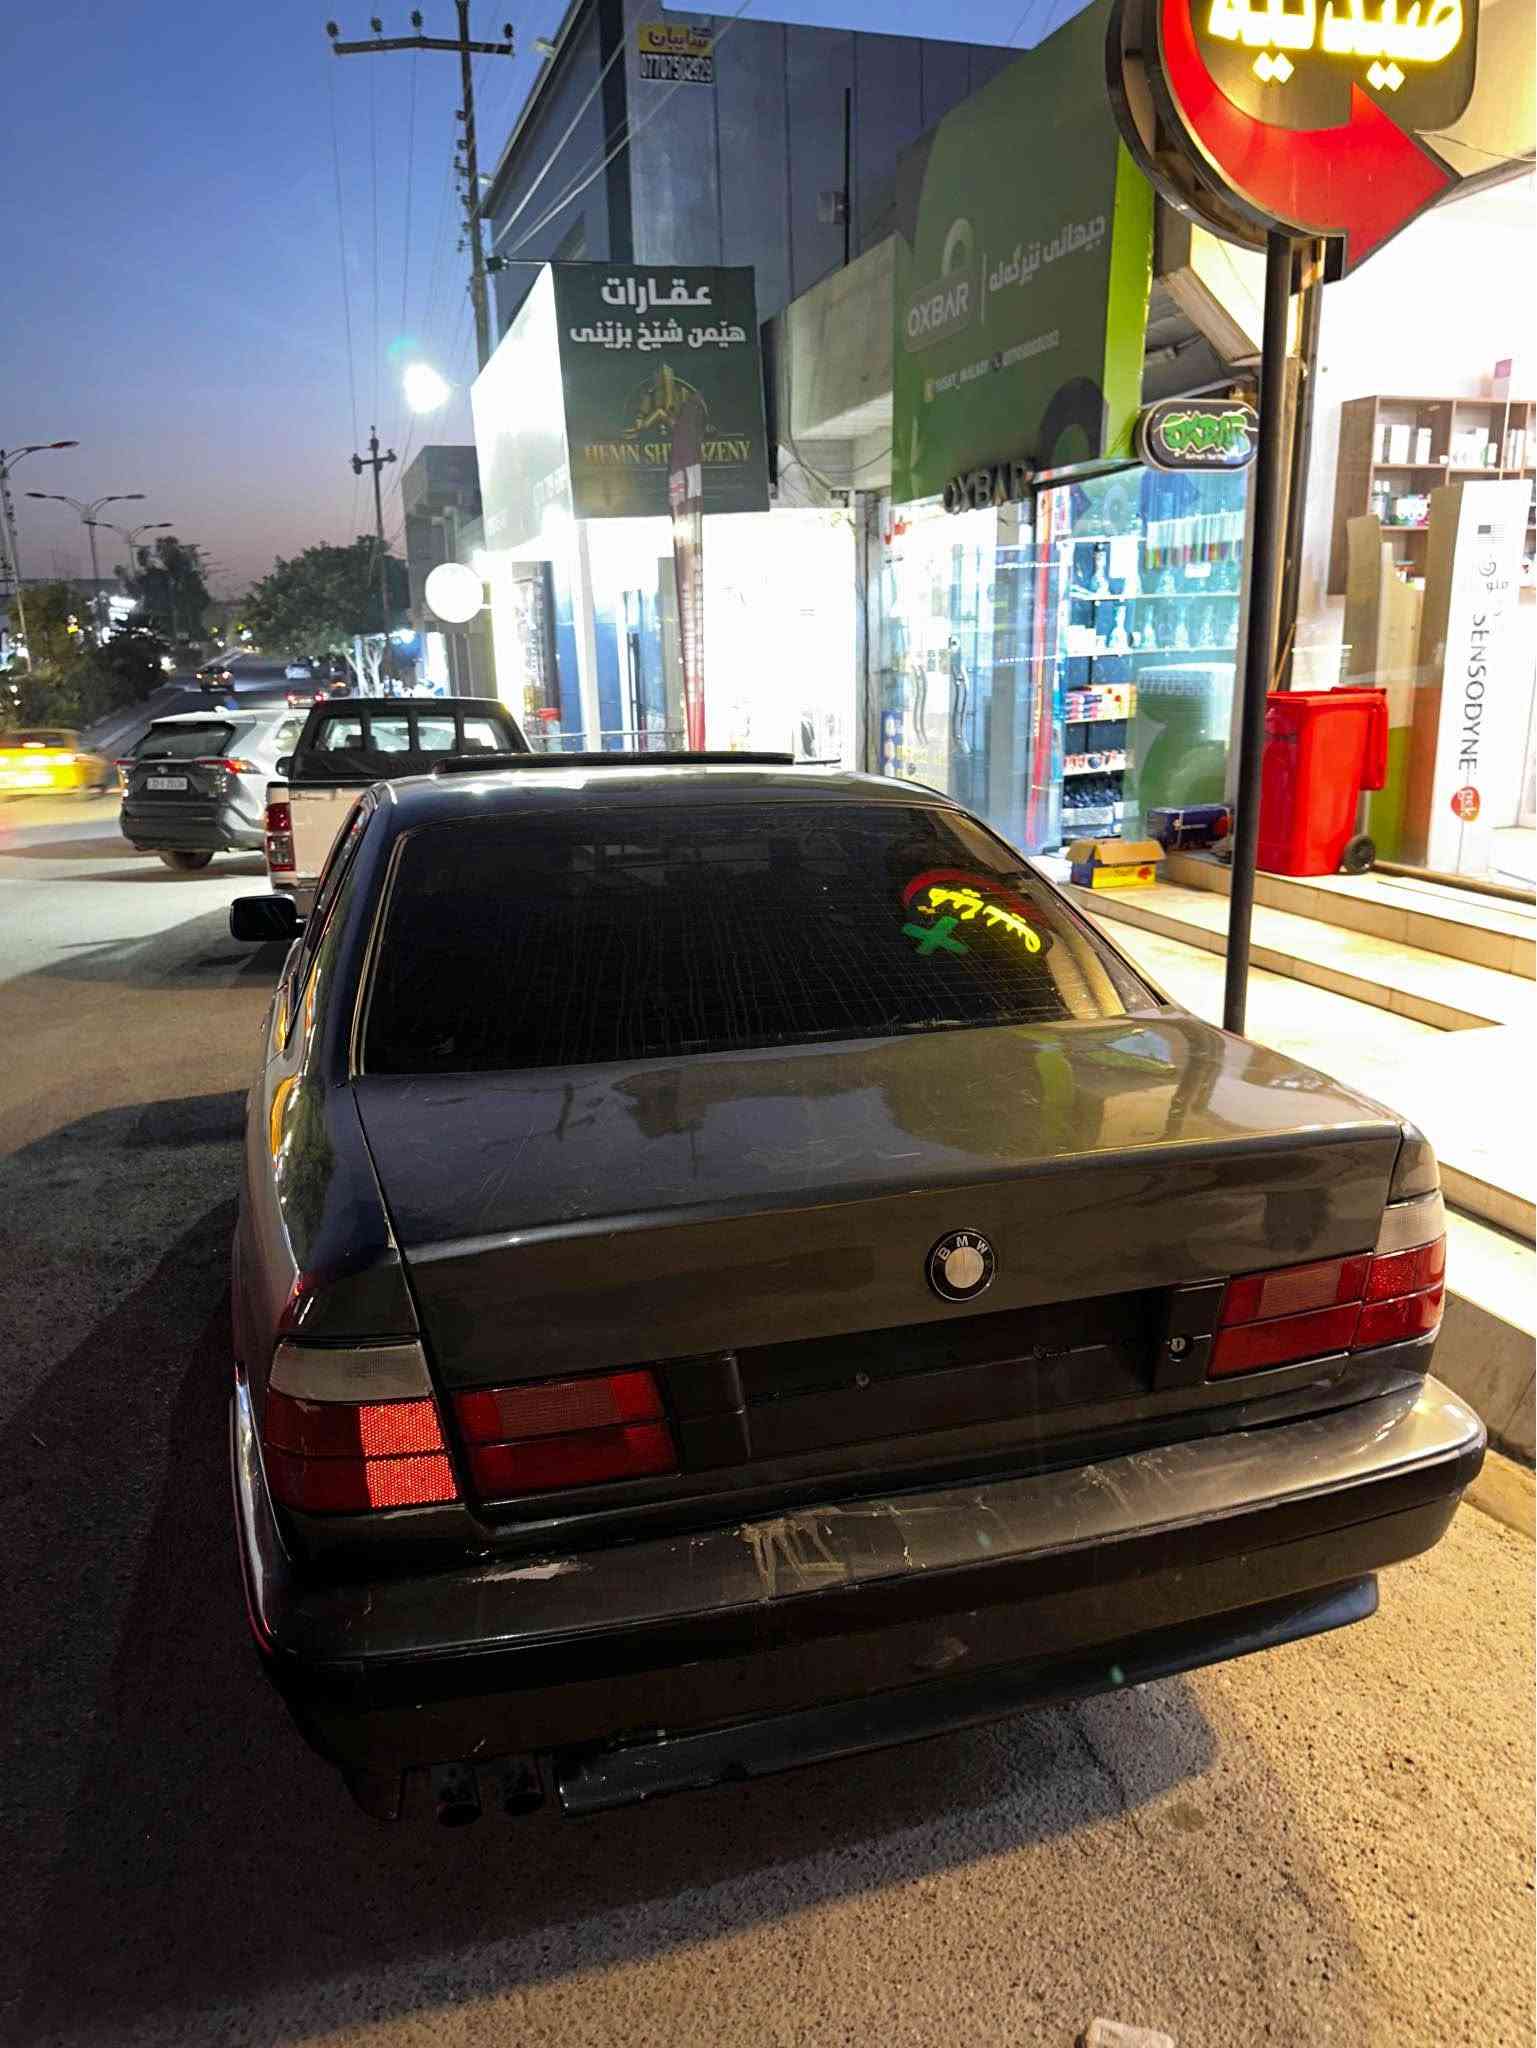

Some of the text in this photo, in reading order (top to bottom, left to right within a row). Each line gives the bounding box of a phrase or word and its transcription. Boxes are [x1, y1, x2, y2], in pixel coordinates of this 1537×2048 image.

[601, 277, 712, 315] عقارات
[908, 282, 969, 337] OXBAR
[584, 440, 640, 465] HEMN
[943, 460, 1029, 515] OXBAR
[1457, 613, 1490, 772] SENSODYNE
[937, 1235, 989, 1261] BMW
